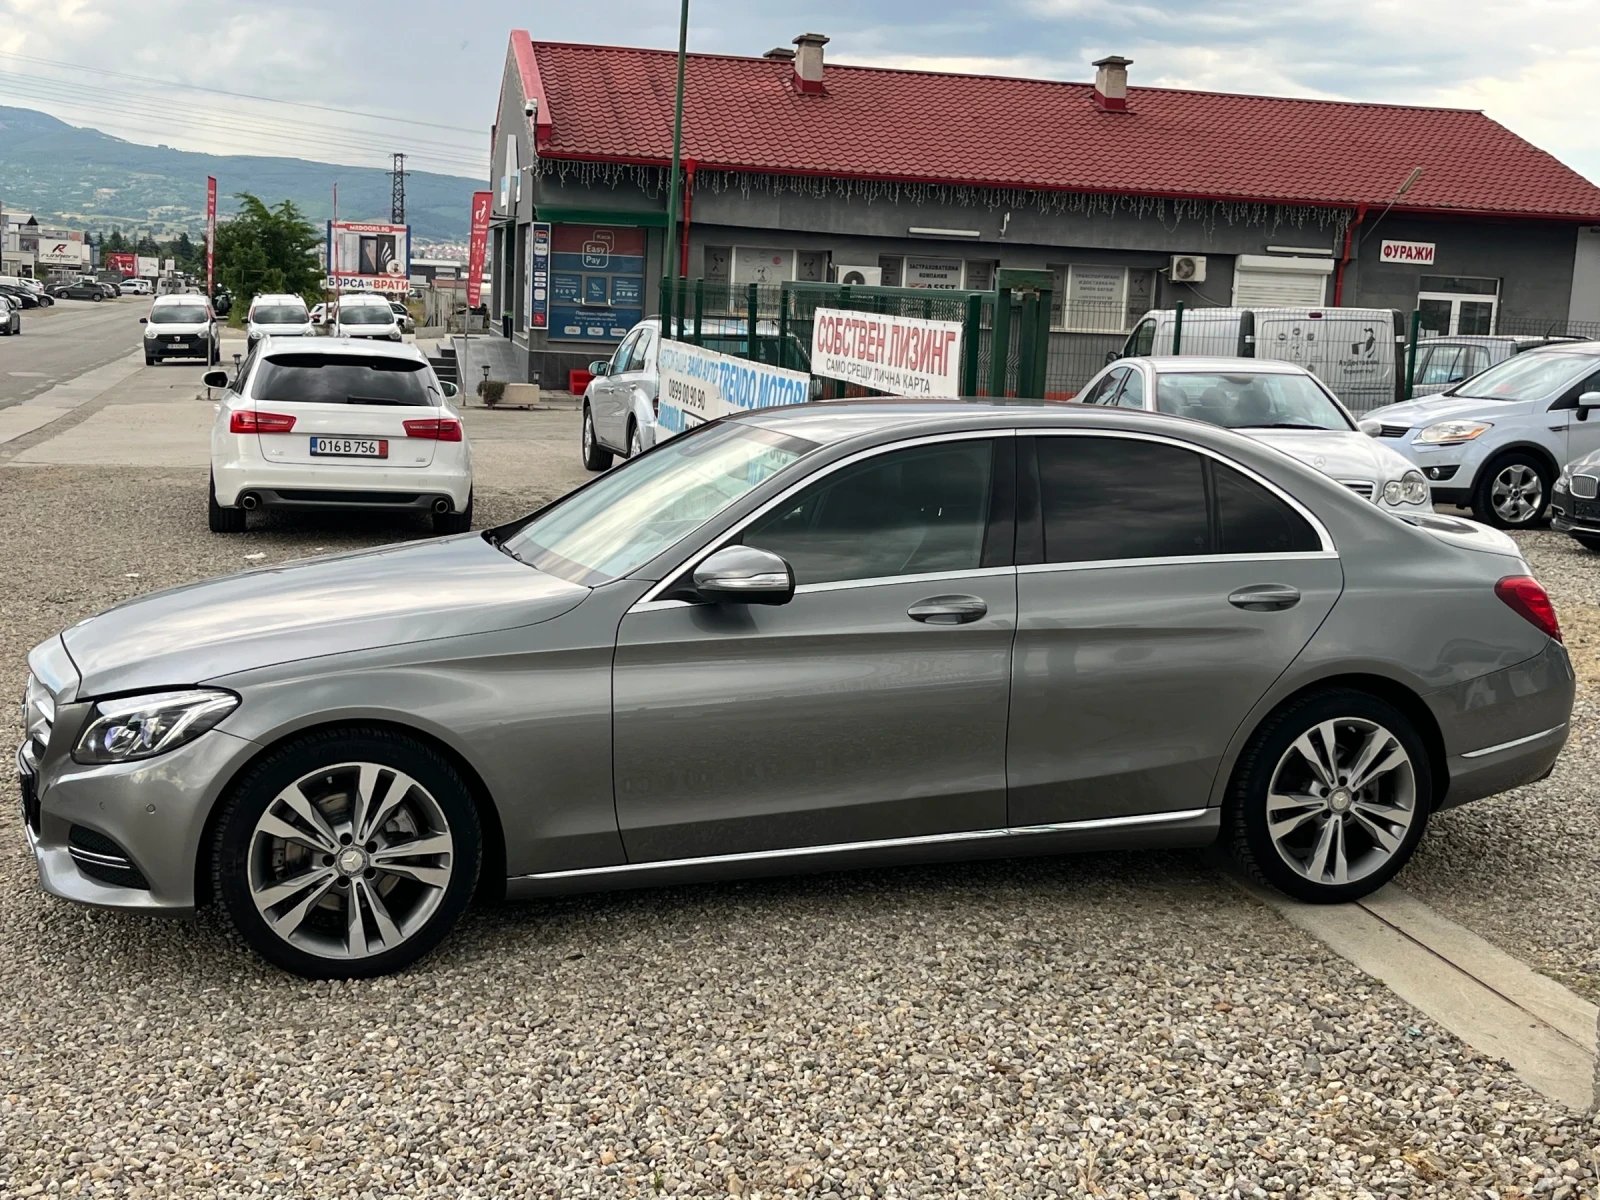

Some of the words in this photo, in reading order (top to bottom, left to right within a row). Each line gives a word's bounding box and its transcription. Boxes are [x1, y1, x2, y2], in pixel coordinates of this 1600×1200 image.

[586, 245, 606, 254] Easy
[1383, 244, 1433, 261] ФУРАЖИ
[586, 256, 601, 265] Pay
[909, 263, 959, 271] ЗАСТРАХОВАТЕЛНА
[328, 277, 365, 288] БОРСА
[373, 279, 409, 291] ВРАТИ
[817, 315, 887, 364] СОБСТВЕН
[888, 325, 956, 377] ЛИЗИНГ
[826, 358, 846, 373] САМО
[847, 362, 873, 380] СРЕЩУ
[873, 369, 901, 387] ЛИЧНА
[902, 375, 931, 395] КАРТА
[719, 361, 757, 410] TRENDO
[668, 378, 682, 401] 0899
[682, 383, 689, 405] 00
[689, 385, 697, 408] 90
[697, 388, 706, 411] 90
